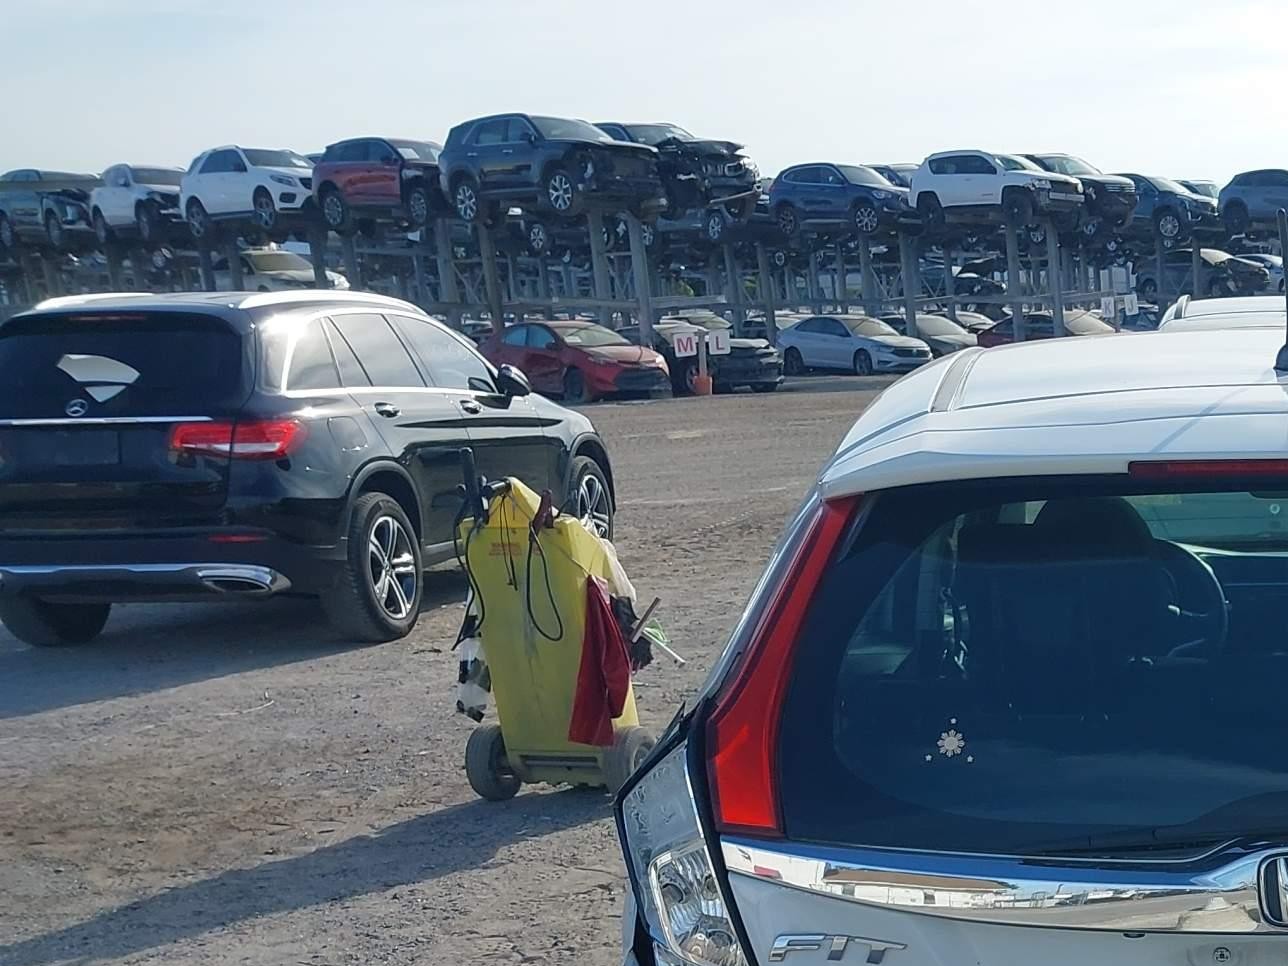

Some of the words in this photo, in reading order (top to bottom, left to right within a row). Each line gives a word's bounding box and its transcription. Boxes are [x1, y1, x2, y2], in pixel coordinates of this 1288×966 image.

[676, 336, 694, 353] M
[715, 335, 725, 350] L
[768, 933, 908, 965] FIT
